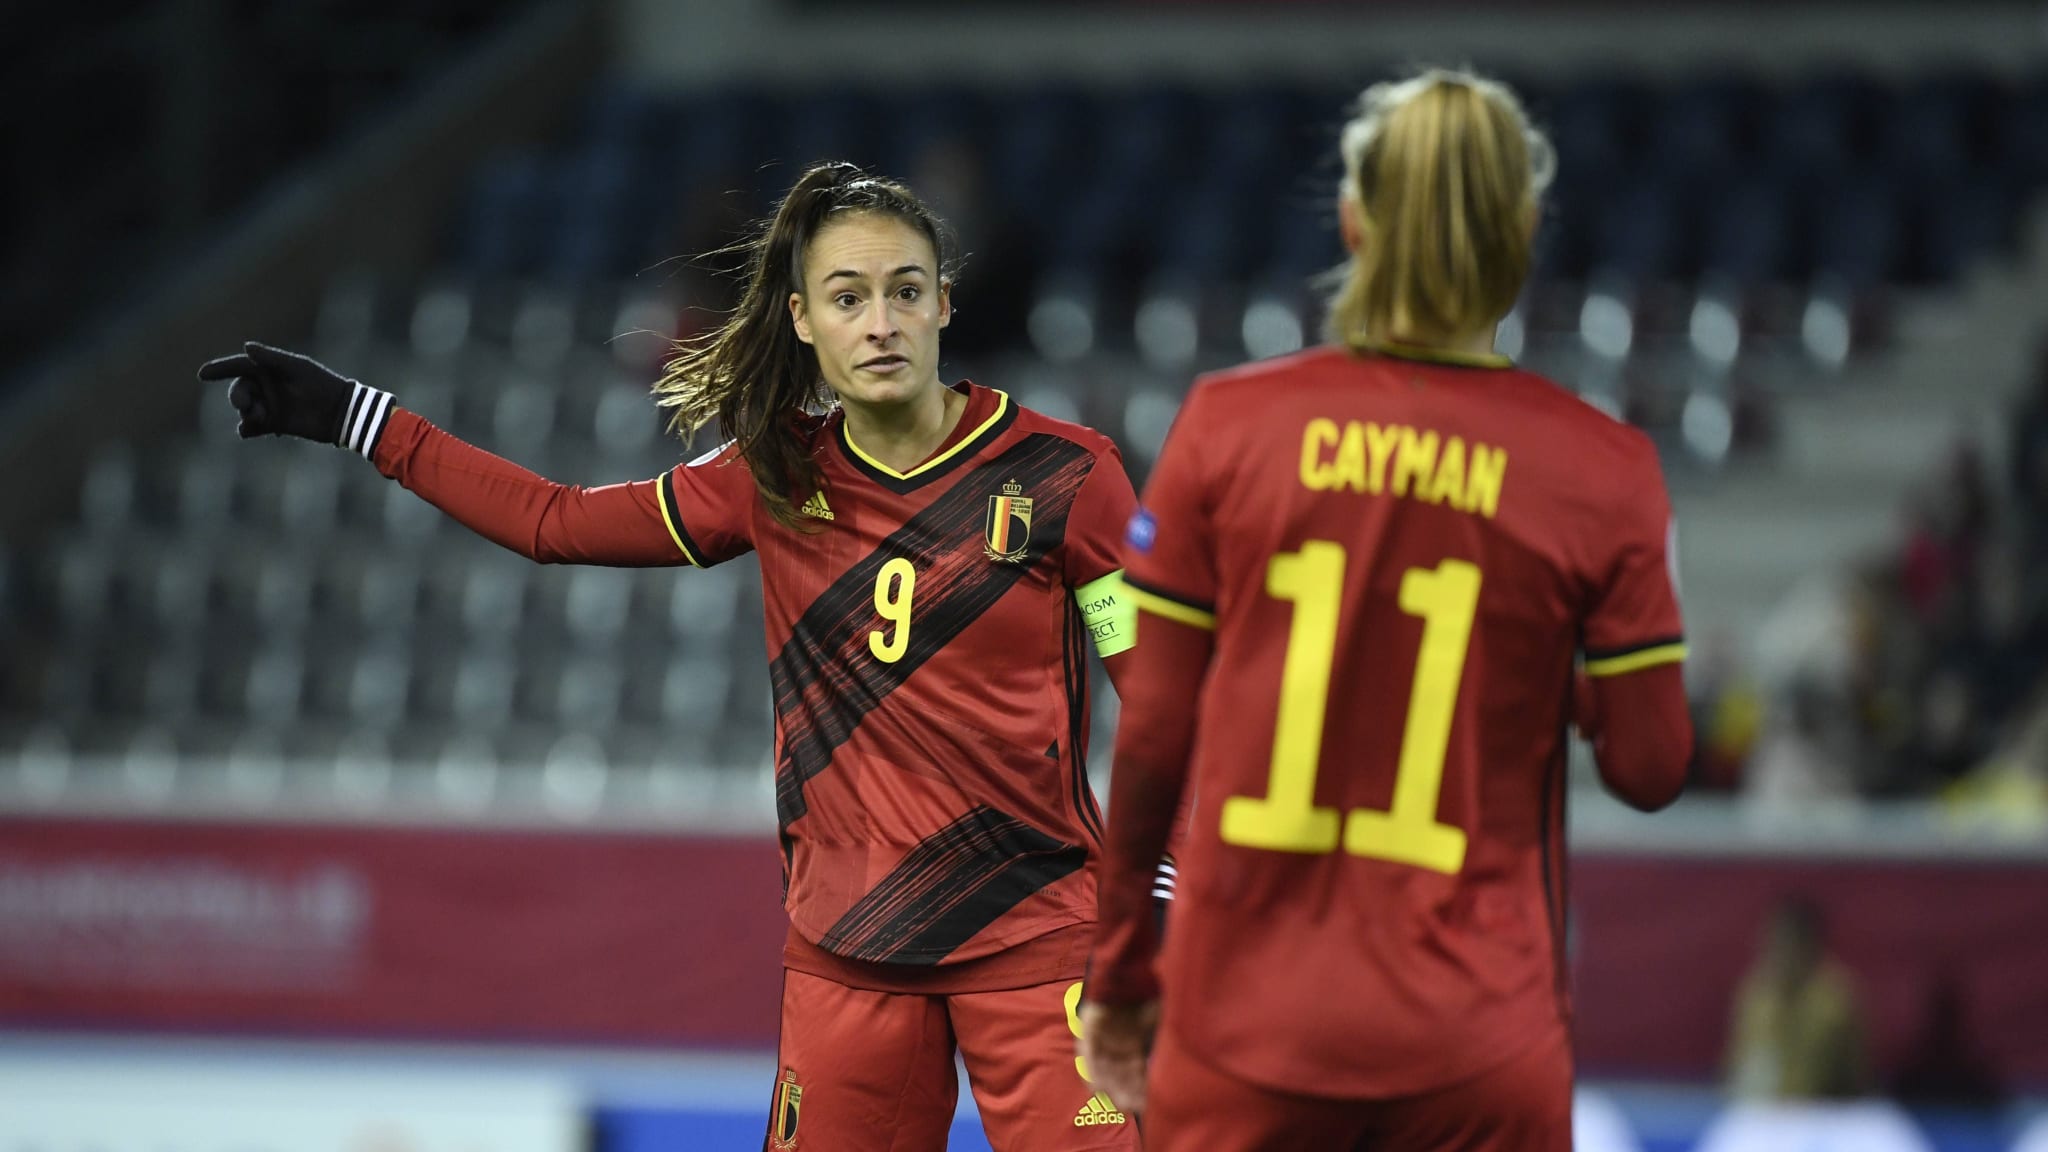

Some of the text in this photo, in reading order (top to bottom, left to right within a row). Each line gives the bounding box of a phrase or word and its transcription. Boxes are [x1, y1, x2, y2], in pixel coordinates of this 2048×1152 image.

[1300, 417, 1507, 518] CAYMAN
[802, 506, 834, 520] adidas
[868, 557, 916, 664] 9
[1080, 595, 1116, 616] ACISM
[1088, 621, 1115, 640] PECT
[1219, 538, 1483, 876] 11
[1074, 1112, 1126, 1127] adidas
